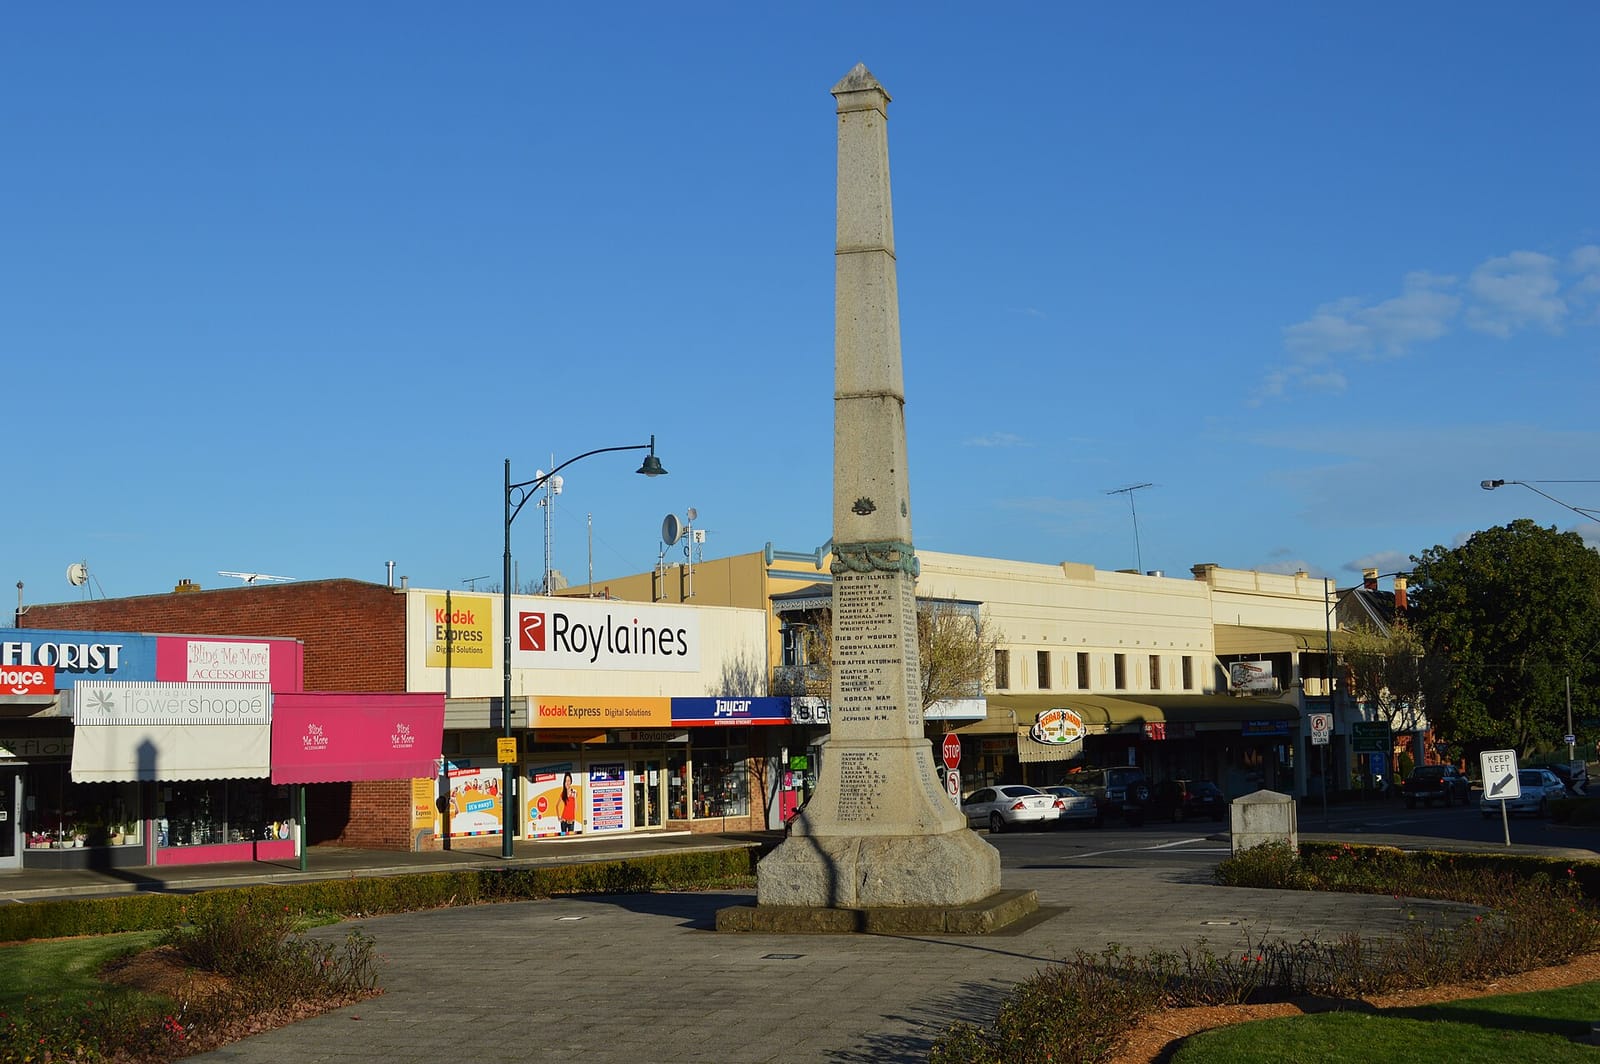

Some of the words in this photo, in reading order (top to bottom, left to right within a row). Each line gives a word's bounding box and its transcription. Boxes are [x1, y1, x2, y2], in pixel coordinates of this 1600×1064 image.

[435, 608, 475, 625] Kodak
[436, 625, 483, 644] Express
[553, 613, 688, 663] Roylaines
[3, 641, 123, 669] FLORIST
[190, 644, 219, 667] Bling
[221, 647, 238, 665] Me
[240, 648, 267, 666] More
[456, 645, 483, 654] Solutions
[192, 669, 266, 680] ACCESSORIES
[539, 705, 567, 717] Kodak
[568, 705, 601, 719] Express
[604, 708, 624, 718] Digital
[625, 708, 652, 717] Solutions
[1041, 711, 1060, 728] KEBAB
[944, 745, 960, 759] STOP
[1488, 754, 1510, 763] KEEP
[1490, 764, 1510, 773] LEFT
